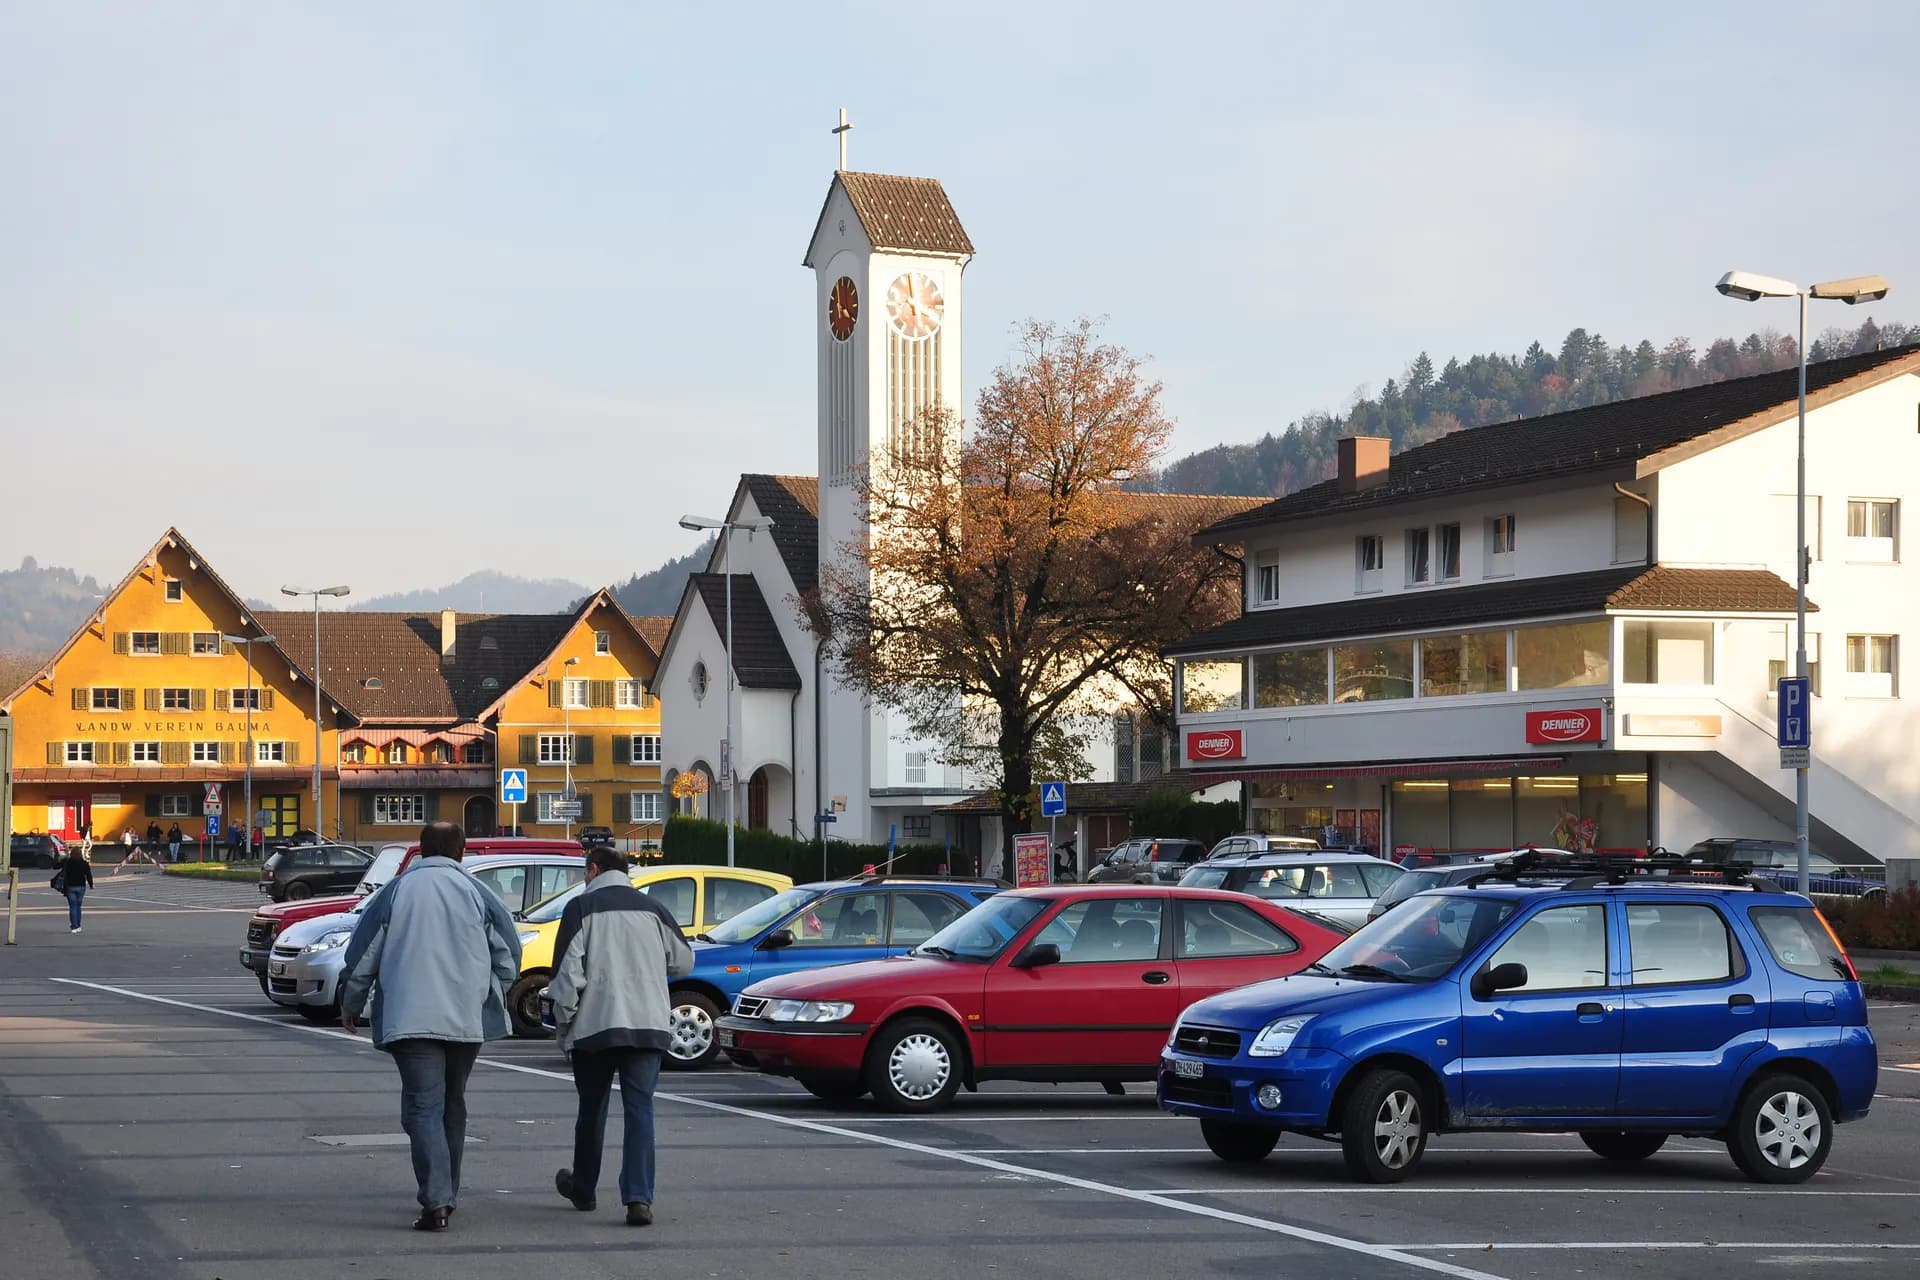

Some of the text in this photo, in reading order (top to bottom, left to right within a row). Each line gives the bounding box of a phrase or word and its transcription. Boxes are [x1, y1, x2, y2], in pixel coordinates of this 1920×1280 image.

[1787, 685, 1799, 716] P
[144, 722, 204, 732] VEREIN
[215, 722, 271, 732] BAUMA
[1542, 718, 1585, 730] DENNER
[1199, 738, 1229, 749] DENNER
